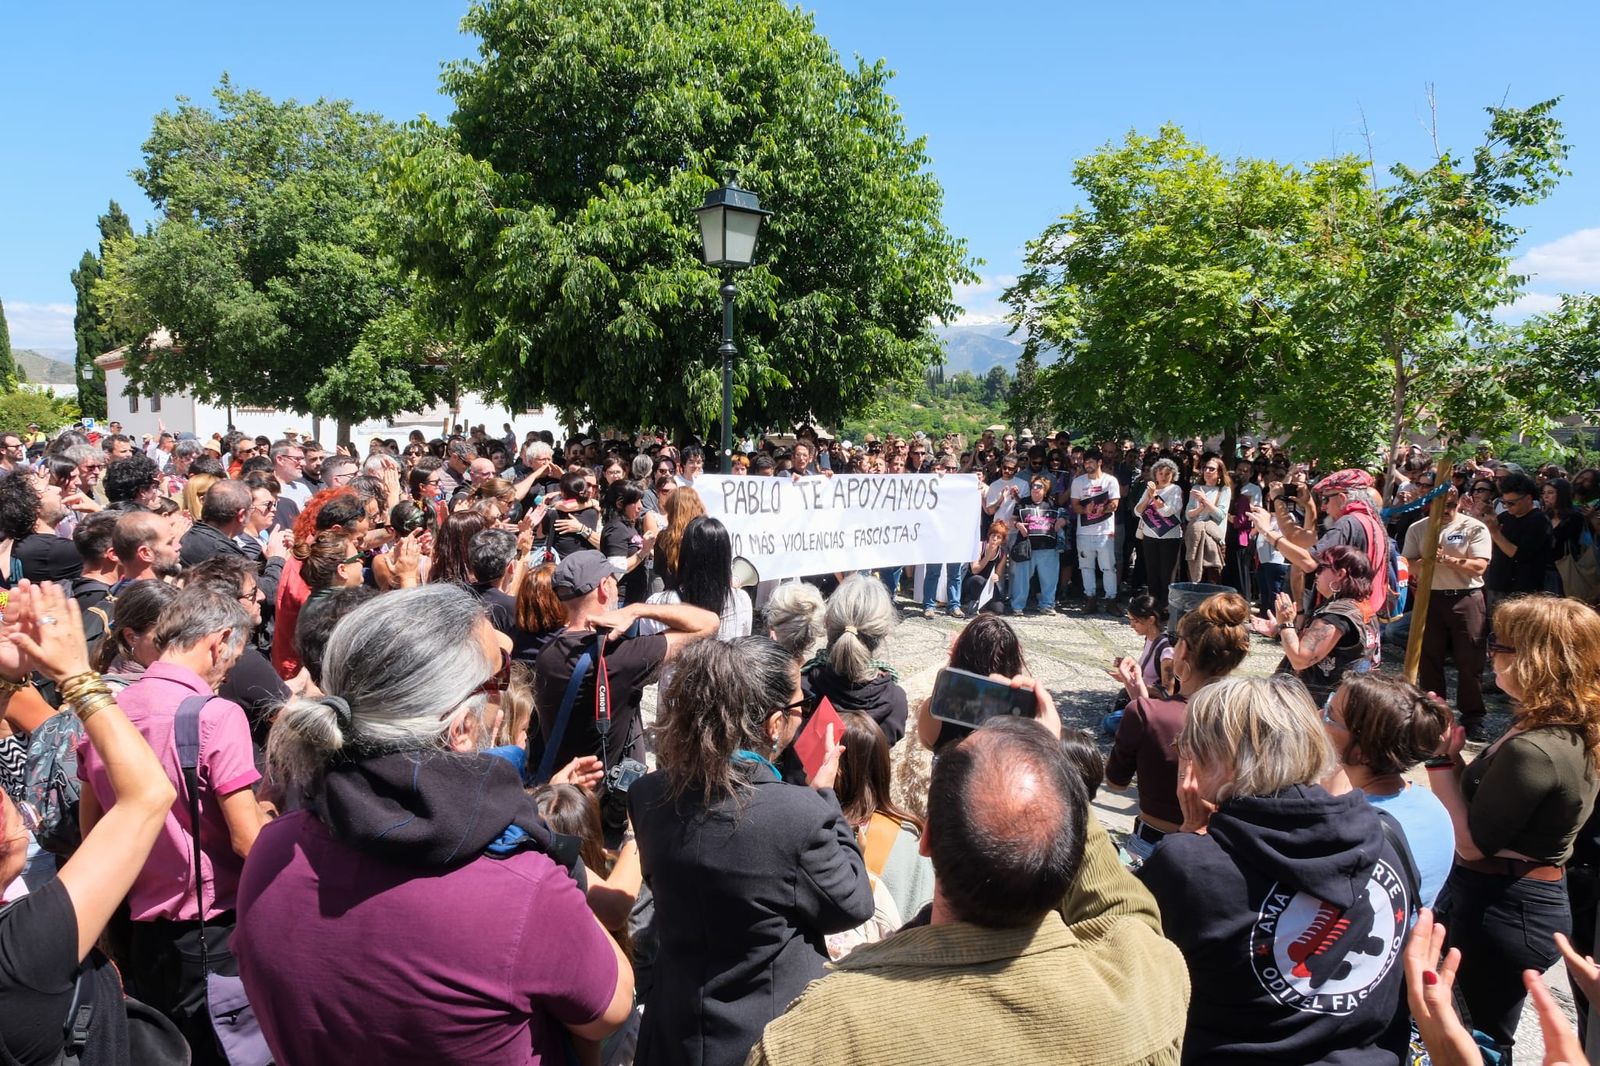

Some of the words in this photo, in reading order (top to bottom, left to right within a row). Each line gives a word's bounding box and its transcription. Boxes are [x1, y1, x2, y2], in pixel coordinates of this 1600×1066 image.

[722, 480, 780, 514] PABLO
[792, 480, 823, 510] TE
[832, 477, 939, 511] APOYAMOS
[749, 531, 775, 555] MÁS
[782, 531, 845, 552] VIOLENCIAS
[854, 522, 921, 548] FASCISTAS
[1259, 894, 1290, 933] AMA
